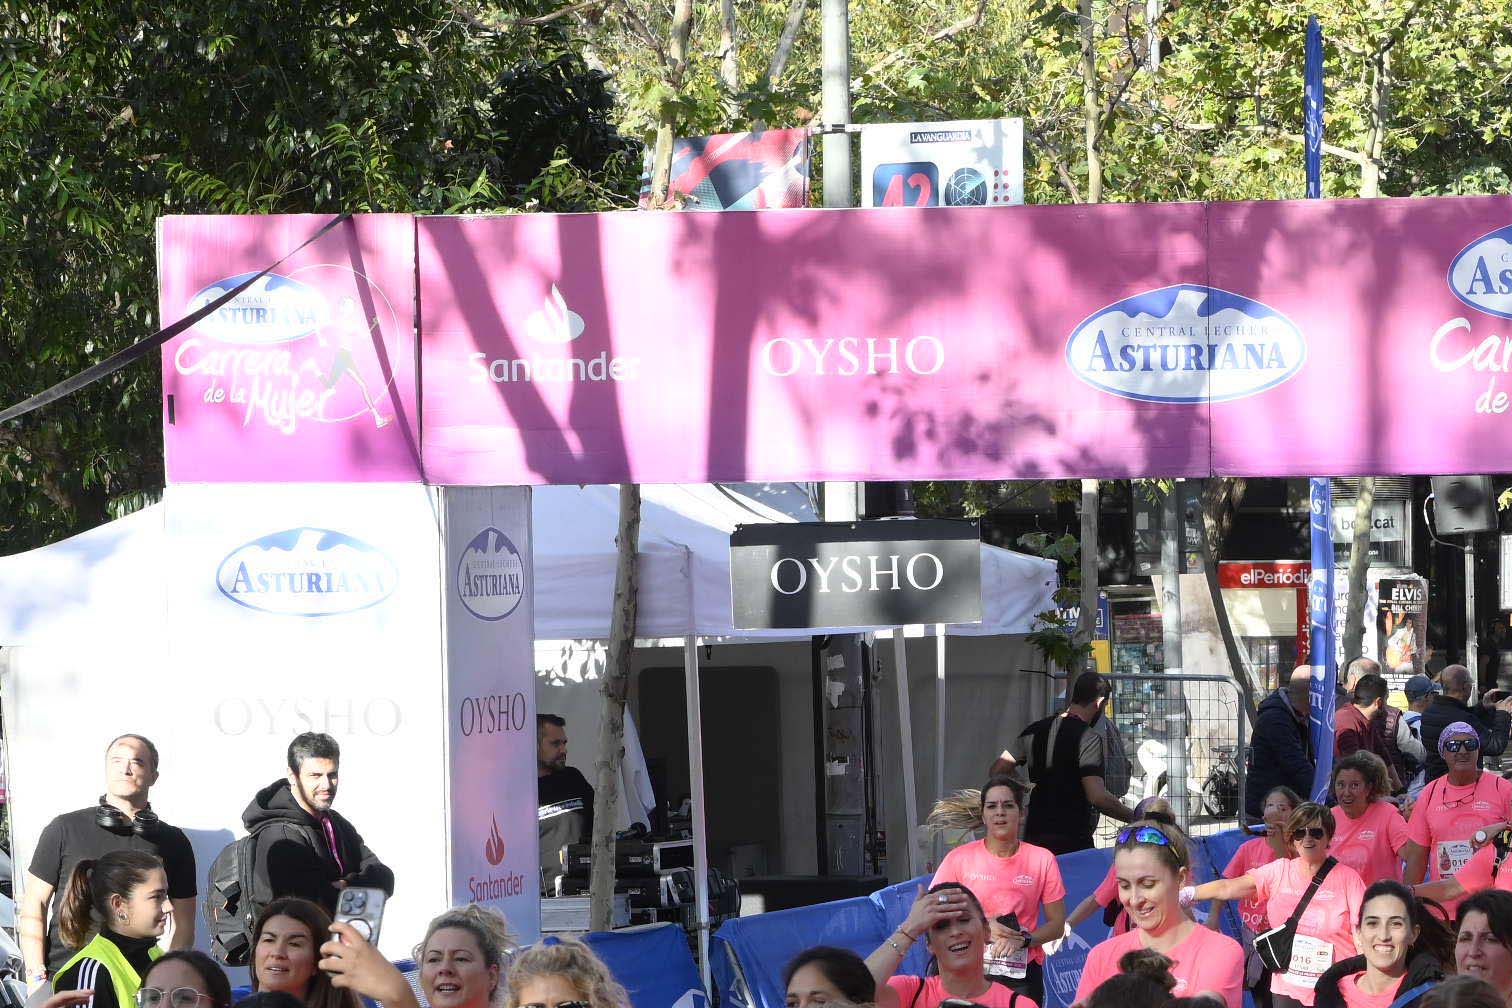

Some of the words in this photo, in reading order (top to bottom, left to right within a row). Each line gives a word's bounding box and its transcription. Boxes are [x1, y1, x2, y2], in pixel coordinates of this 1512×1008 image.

[468, 350, 640, 384] Santander
[762, 335, 945, 378] OYSHO
[1085, 329, 1287, 373] ASTURIANA
[1475, 376, 1510, 415] de
[462, 565, 521, 598] ASTURIANA
[769, 552, 944, 595] OYSHO
[1391, 587, 1422, 601] ELVIS
[212, 697, 403, 737] OYSHO
[458, 692, 527, 737] OYSHO
[469, 837, 525, 903] Santander
[1292, 954, 1312, 965] 016
